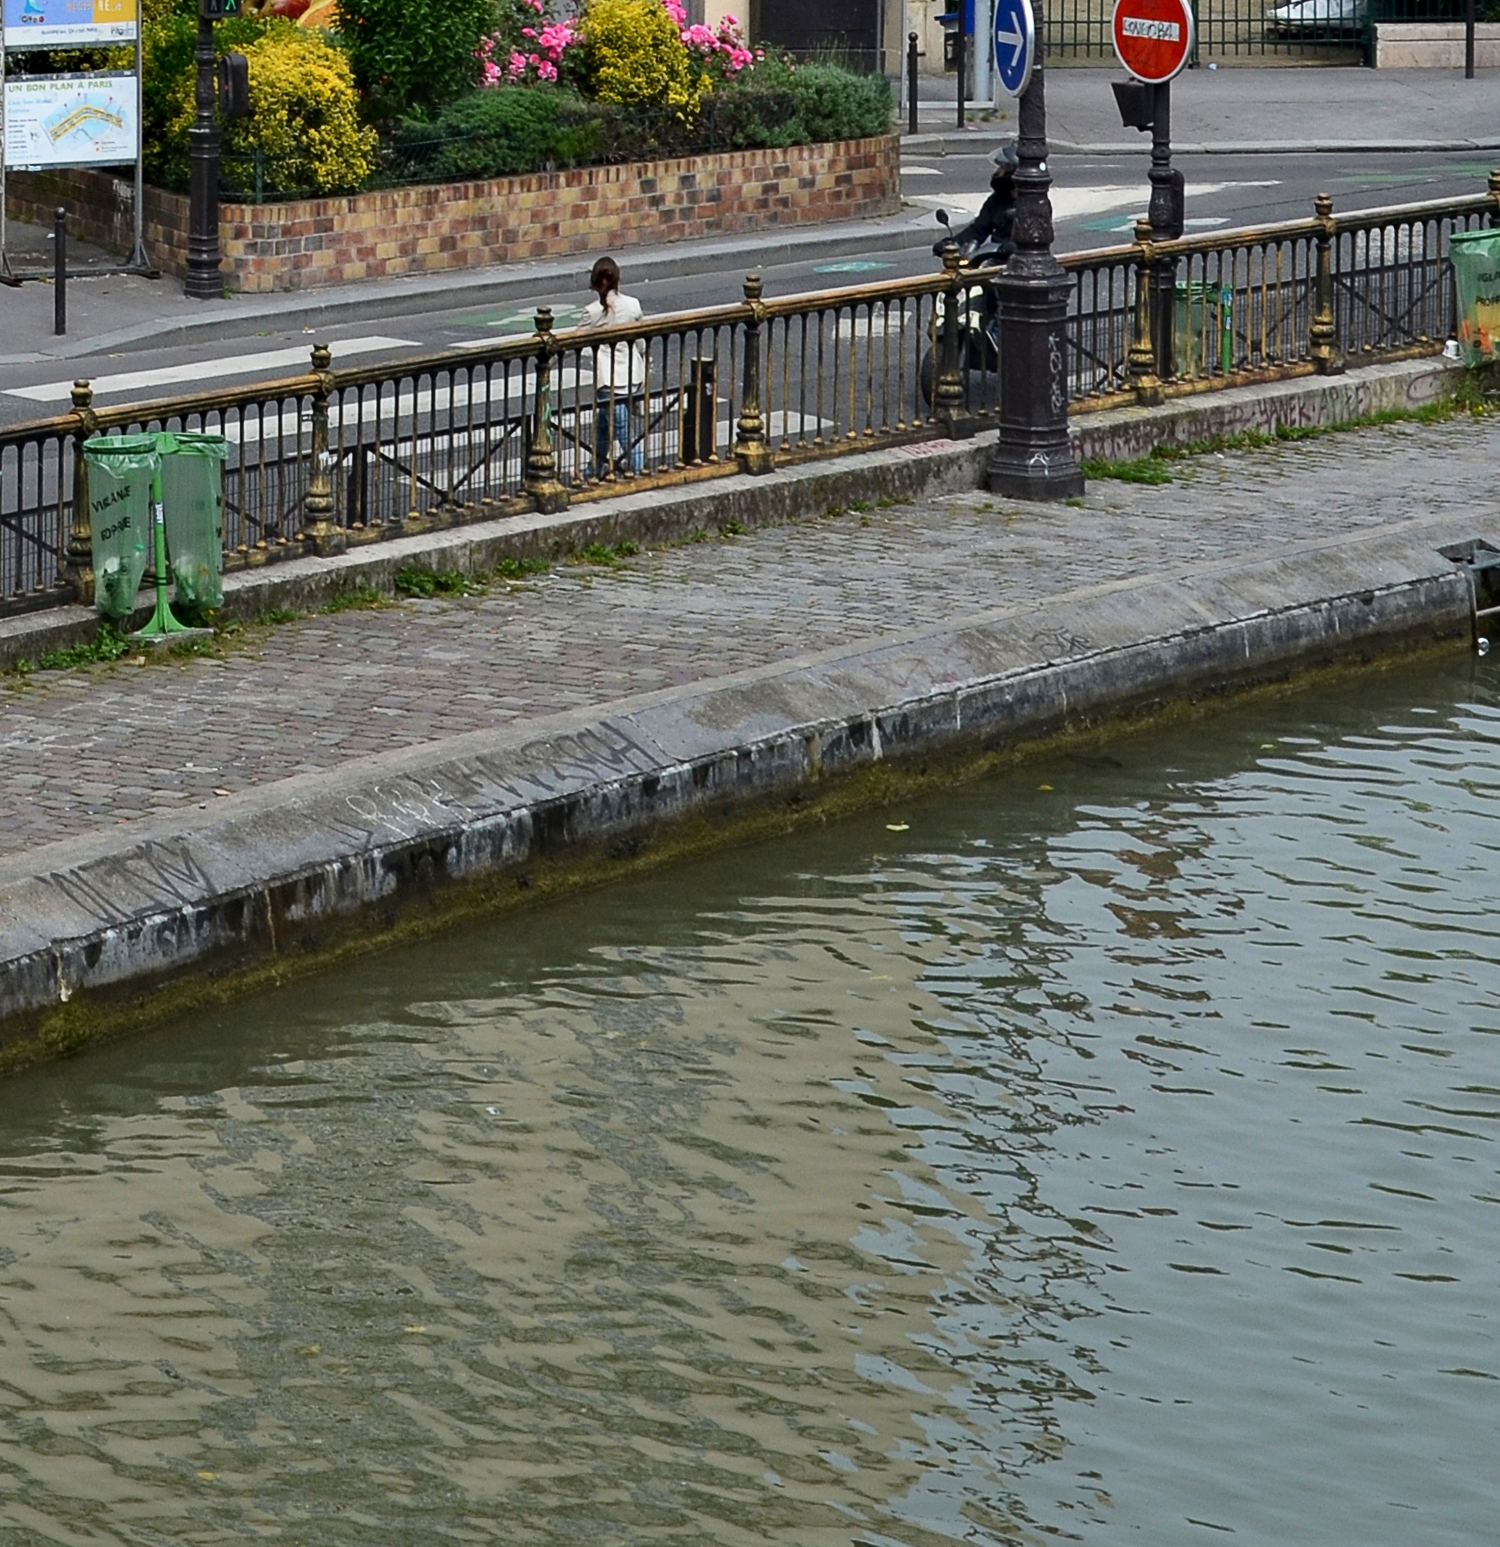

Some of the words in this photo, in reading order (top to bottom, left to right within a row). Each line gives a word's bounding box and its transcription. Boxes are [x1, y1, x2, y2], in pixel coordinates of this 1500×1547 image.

[8, 85, 22, 93] UN
[26, 83, 46, 92] BON
[50, 82, 74, 90] PLAN
[88, 80, 113, 88] PARIS
